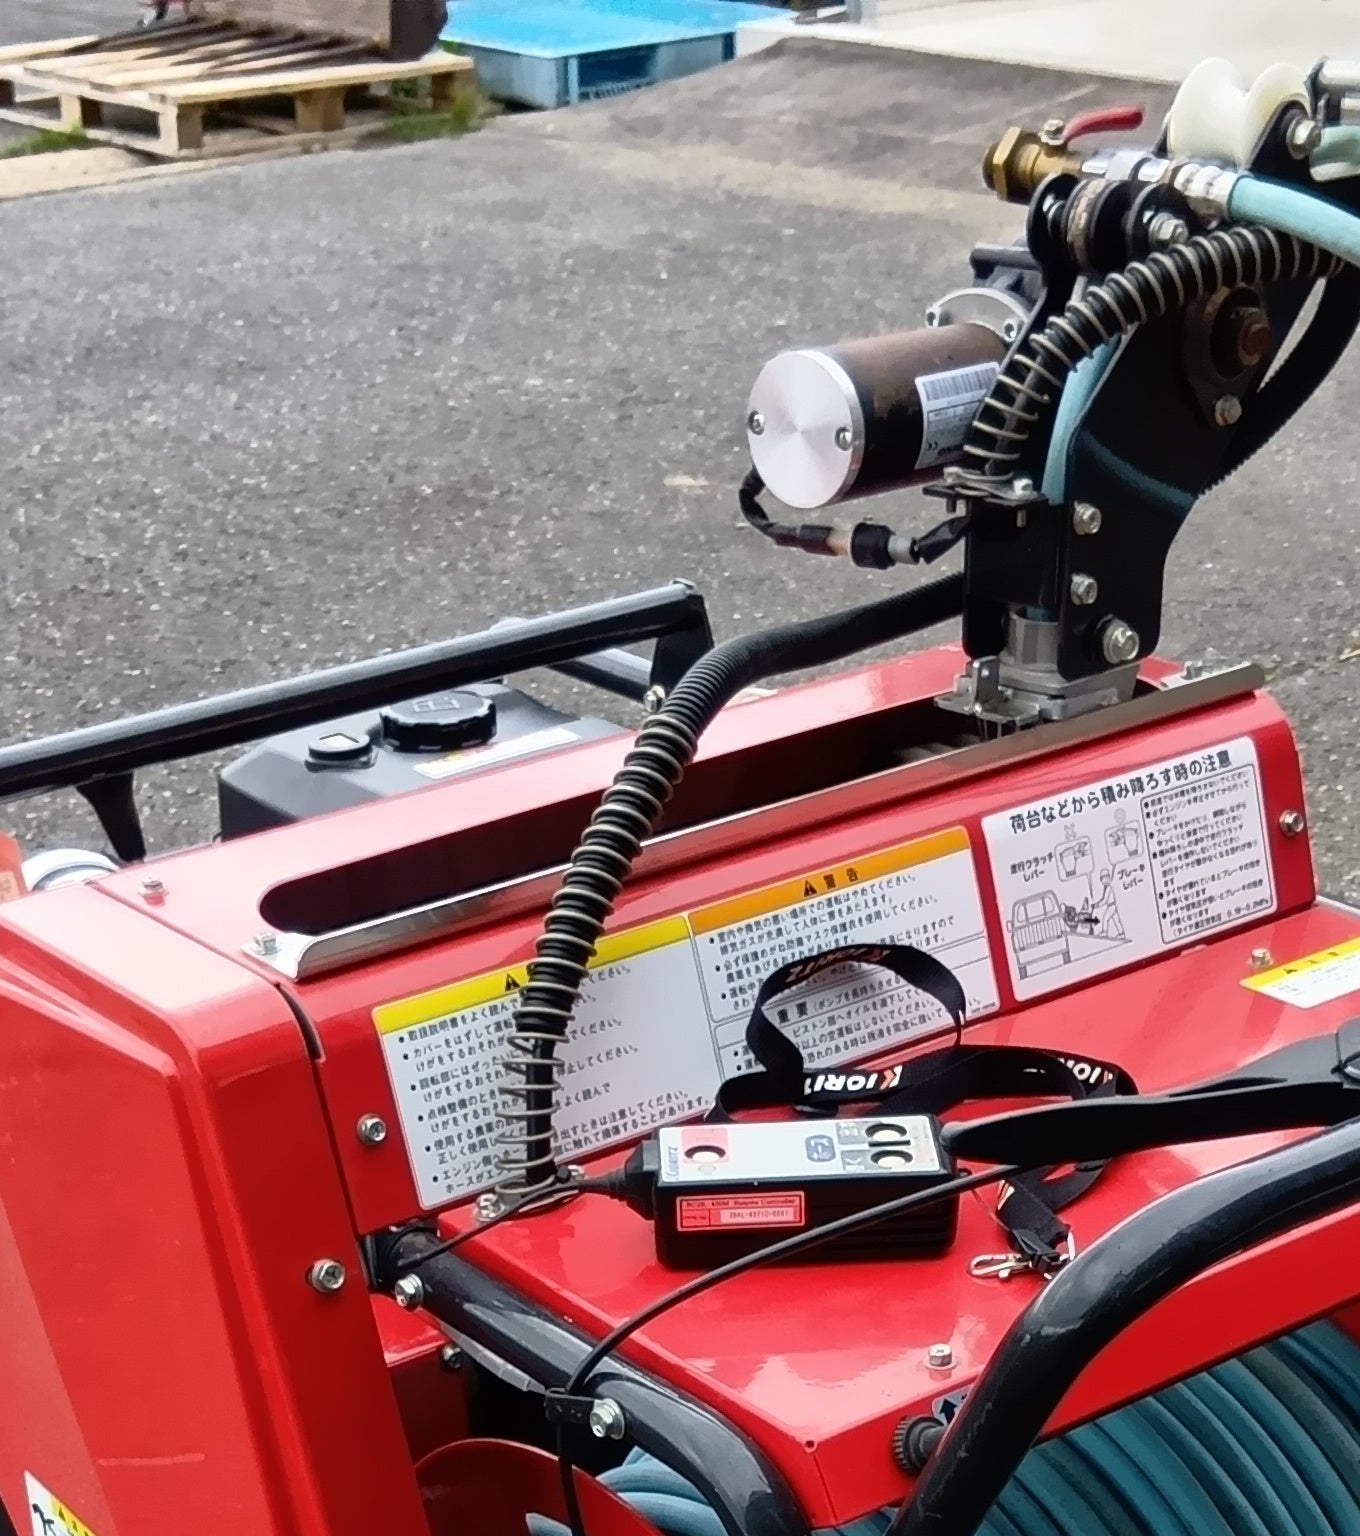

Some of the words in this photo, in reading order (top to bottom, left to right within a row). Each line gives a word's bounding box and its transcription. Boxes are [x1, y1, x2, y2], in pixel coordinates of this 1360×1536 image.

[1009, 748, 1232, 834] 荷台などから積み降ろす時の注意
[824, 866, 859, 890] 警告
[1022, 866, 1045, 883] レバー
[1122, 875, 1143, 890] レバー
[776, 1001, 809, 1025] 重要
